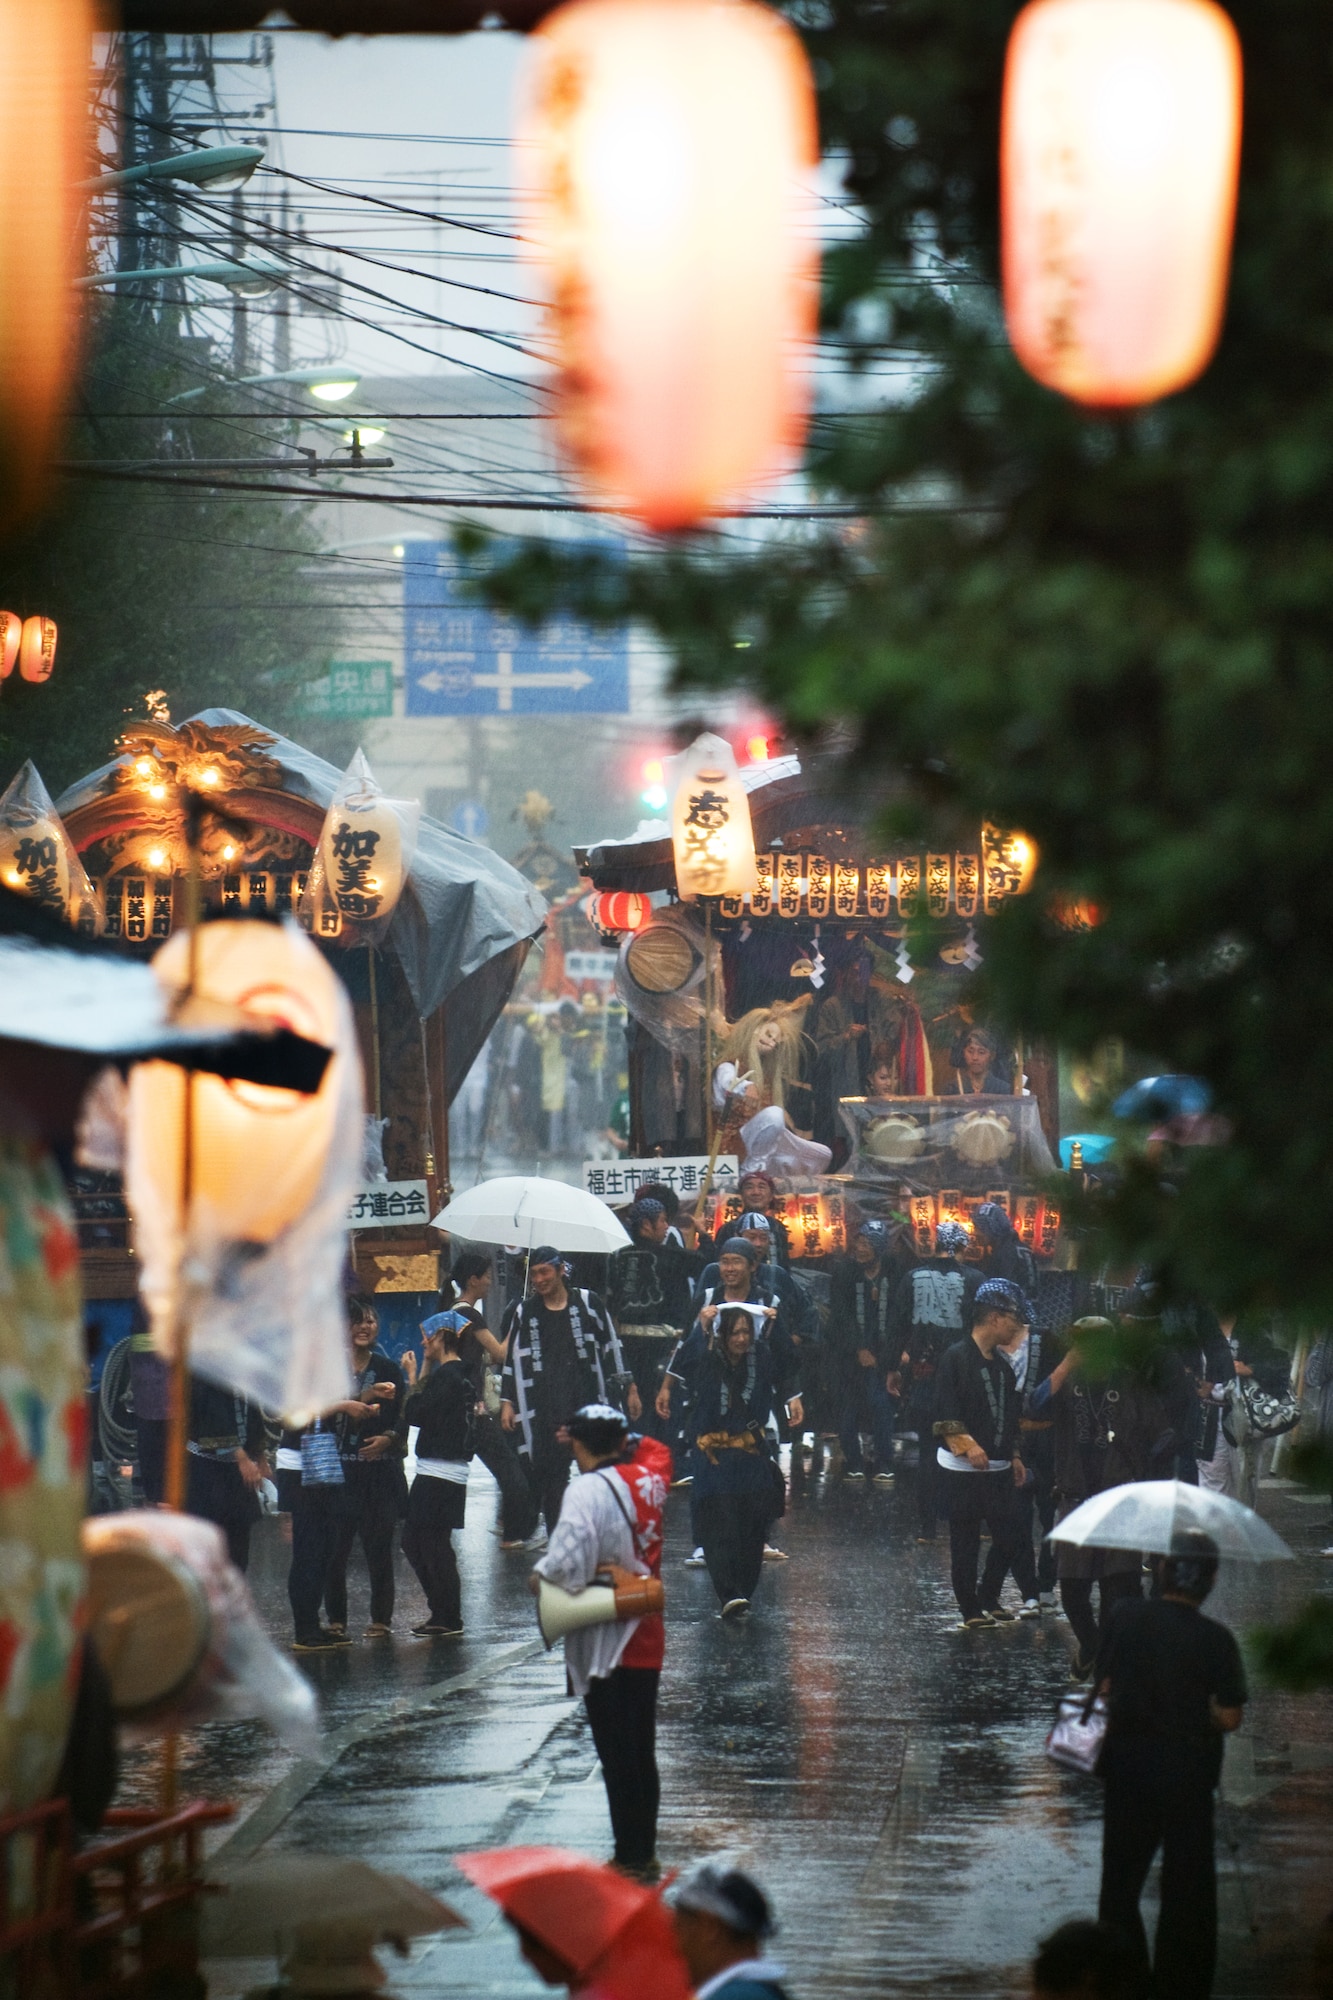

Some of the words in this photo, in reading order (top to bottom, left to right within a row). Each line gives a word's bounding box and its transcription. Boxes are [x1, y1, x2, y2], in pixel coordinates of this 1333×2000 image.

[13, 836, 66, 922] 加美
[224, 875, 242, 911] 加美
[250, 875, 267, 911] 加美
[331, 823, 384, 918] 加美町
[781, 858, 799, 913] 志茂町
[809, 857, 829, 913] 志茂町
[837, 860, 857, 913] 志茂町
[929, 858, 948, 912] 志茂町
[957, 858, 976, 912] 志茂町
[127, 879, 146, 938] 加美町
[153, 879, 171, 936] 加美町
[347, 1190, 426, 1218] 子連合会
